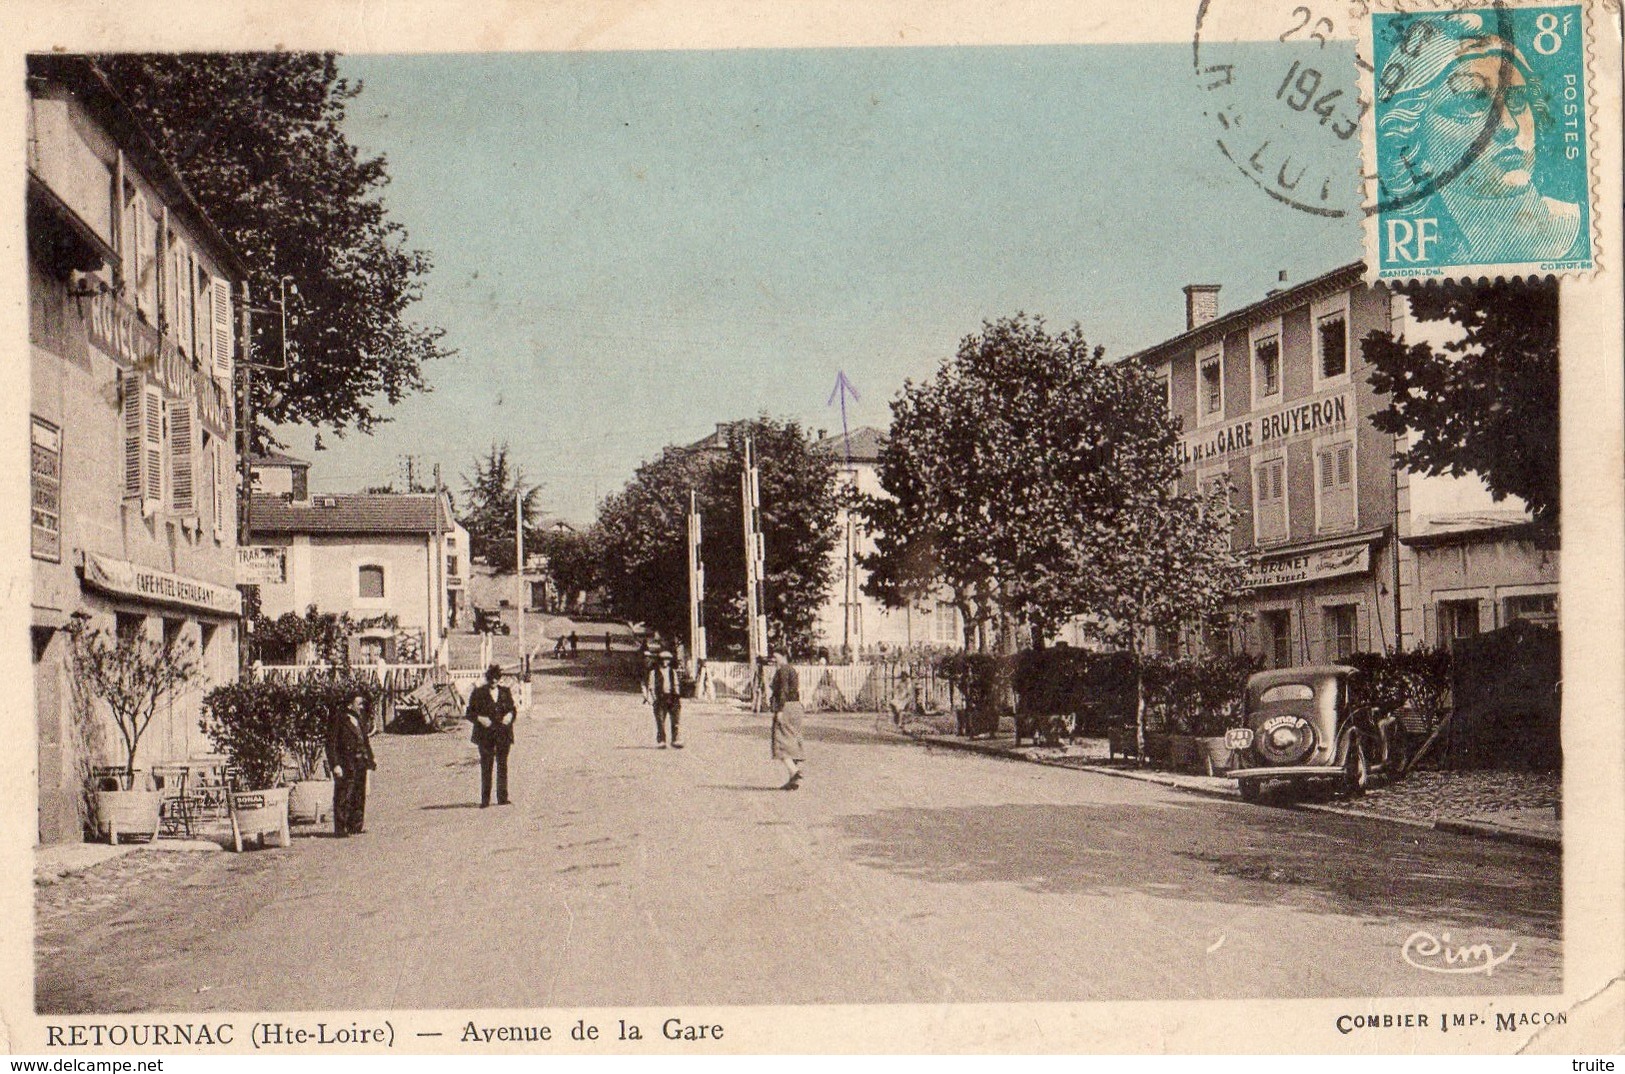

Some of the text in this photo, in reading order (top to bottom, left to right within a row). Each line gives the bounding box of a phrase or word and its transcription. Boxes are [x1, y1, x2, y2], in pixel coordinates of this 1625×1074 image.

[1563, 73, 1580, 161] POSTES
[1383, 217, 1439, 263] RF
[1205, 440, 1217, 459] LA
[1217, 421, 1254, 454] GARE
[1260, 396, 1347, 442] BRUYERON
[1260, 556, 1310, 575] BRUNET
